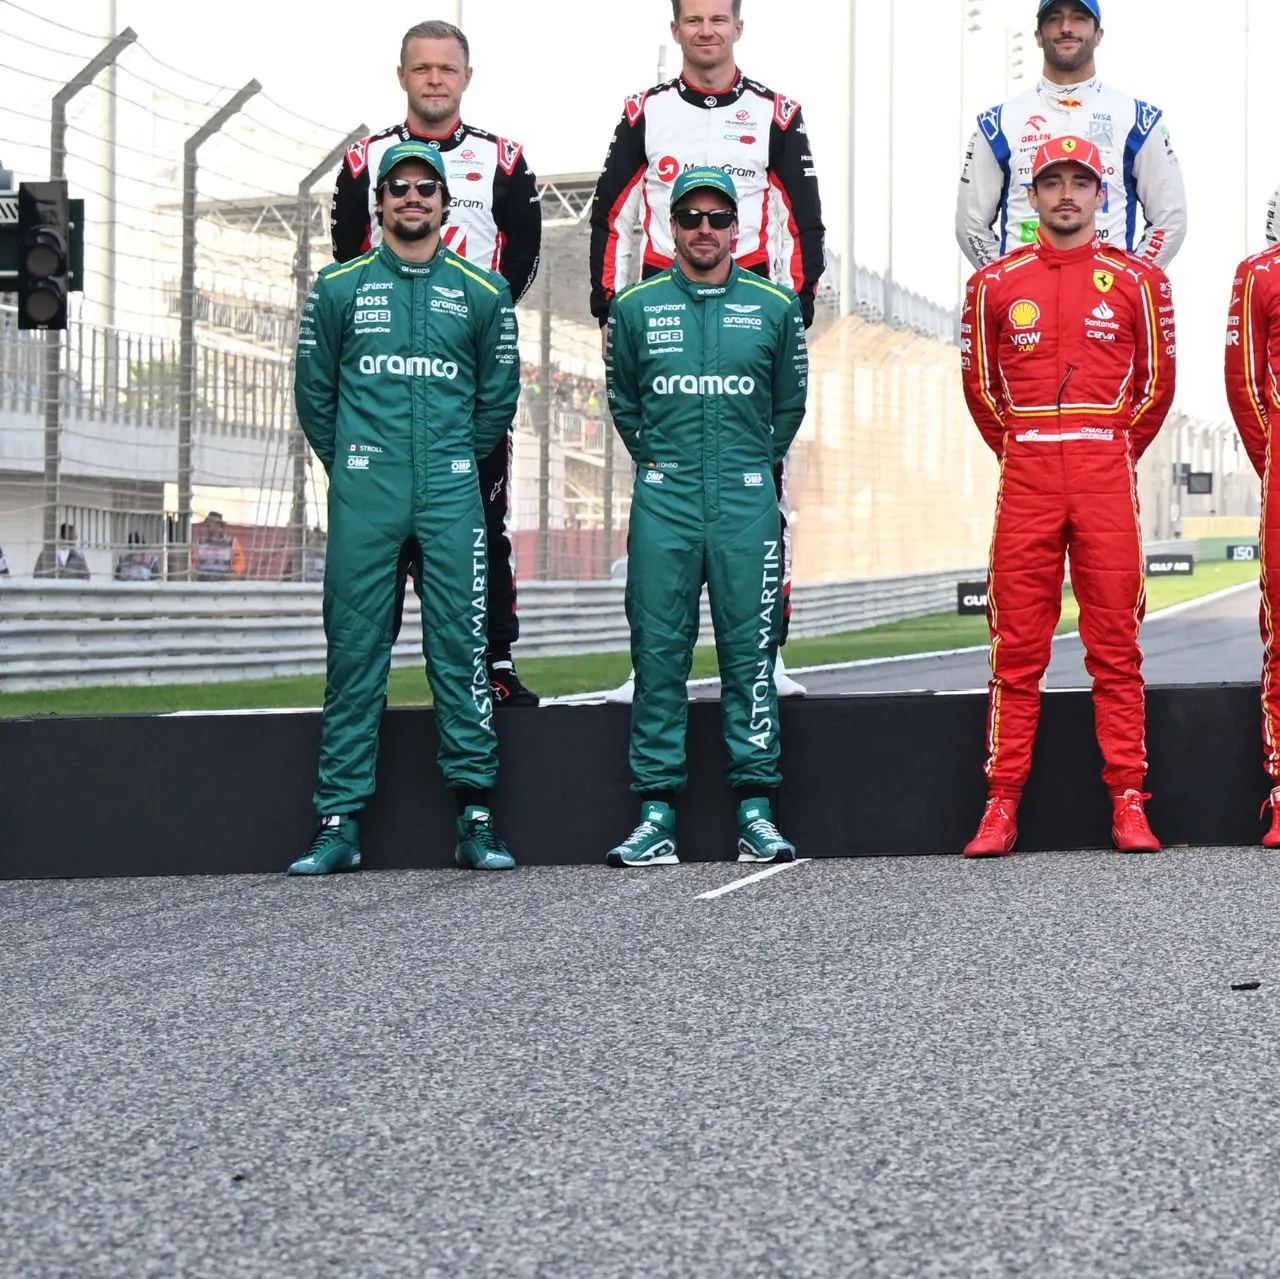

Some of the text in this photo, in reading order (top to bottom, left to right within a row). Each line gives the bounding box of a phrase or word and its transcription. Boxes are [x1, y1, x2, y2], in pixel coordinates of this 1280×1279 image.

[1021, 133, 1051, 143] ORLEN
[356, 296, 388, 306] BOSS
[430, 299, 468, 313] aramco
[644, 303, 686, 314] cognizant
[355, 310, 391, 323] JCB
[649, 317, 680, 327] BOSS
[723, 317, 762, 326] aramco
[1084, 318, 1120, 329] Santander
[647, 330, 683, 344] JCB
[359, 355, 458, 379] aramco
[652, 375, 755, 395] aramco
[359, 445, 383, 453] STROLL
[348, 458, 369, 467] OMP
[452, 462, 471, 471] OMP
[744, 475, 762, 484] OMP
[471, 528, 492, 731] ASTON MARTIN
[748, 540, 778, 751] ASTON MARTIN
